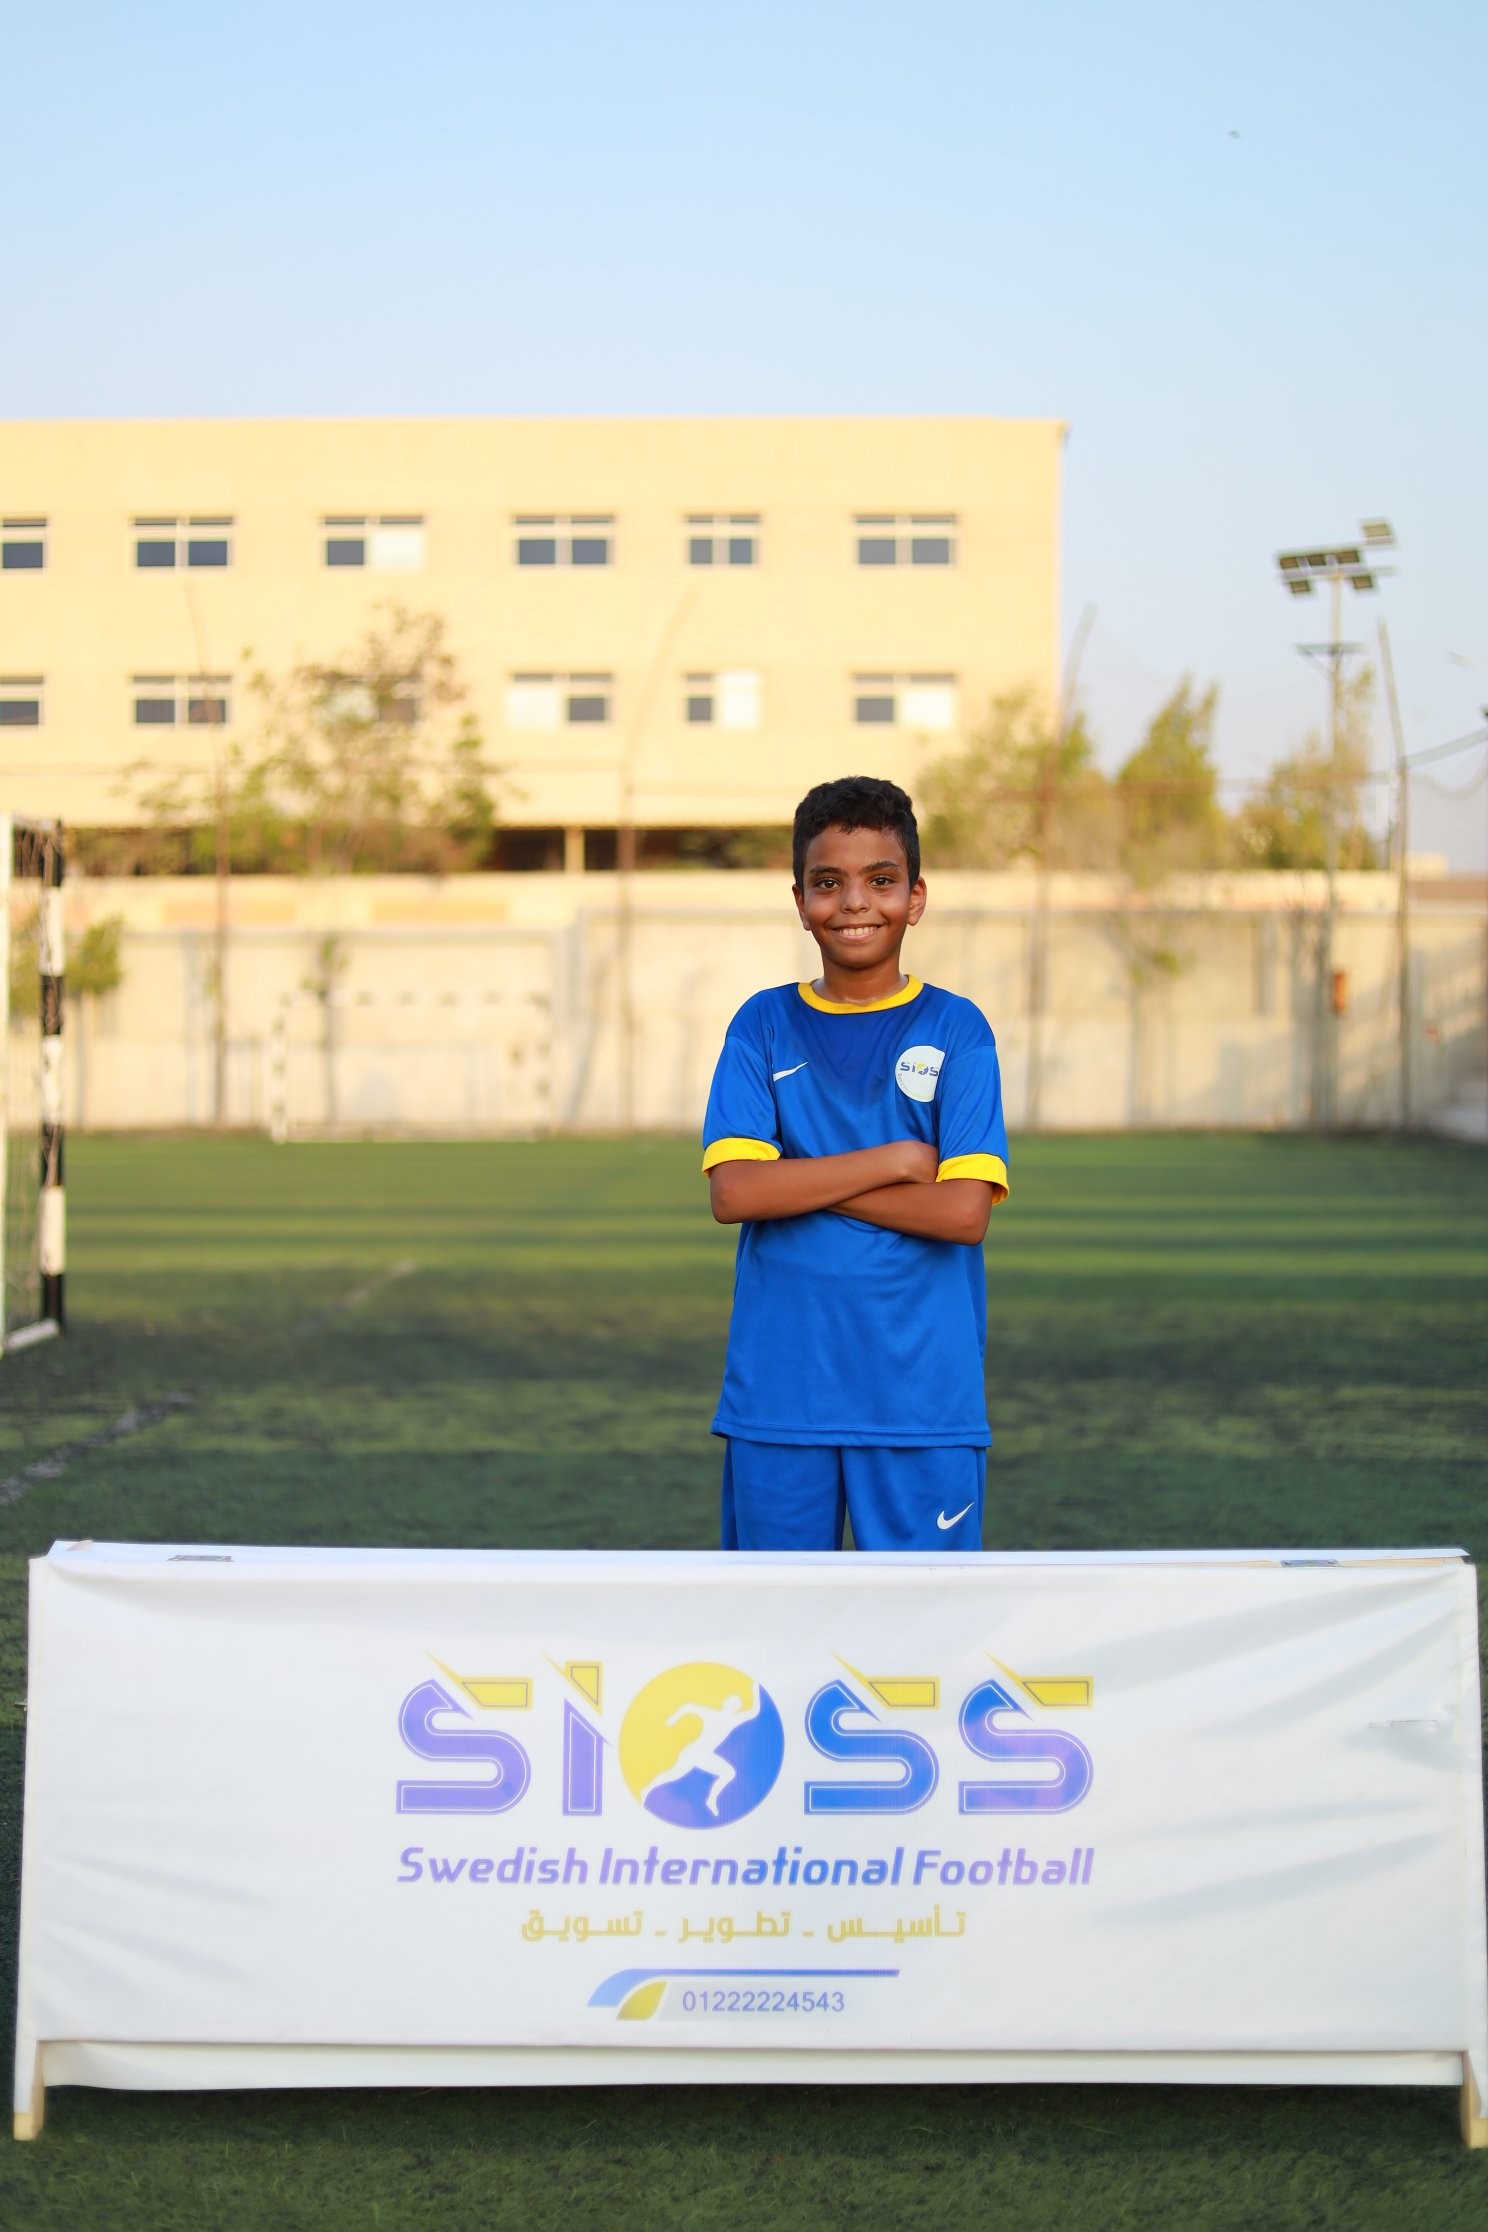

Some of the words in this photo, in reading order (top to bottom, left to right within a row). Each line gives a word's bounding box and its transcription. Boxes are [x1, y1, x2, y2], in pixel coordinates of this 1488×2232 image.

[397, 1846, 589, 1885] Swedish
[599, 1846, 905, 1886] International
[912, 1847, 1095, 1886] Football
[520, 1909, 642, 1943] تسويق
[678, 1910, 792, 1944] تطوير
[827, 1904, 967, 1943] تأسيس
[682, 1991, 846, 2013] 01222224543
